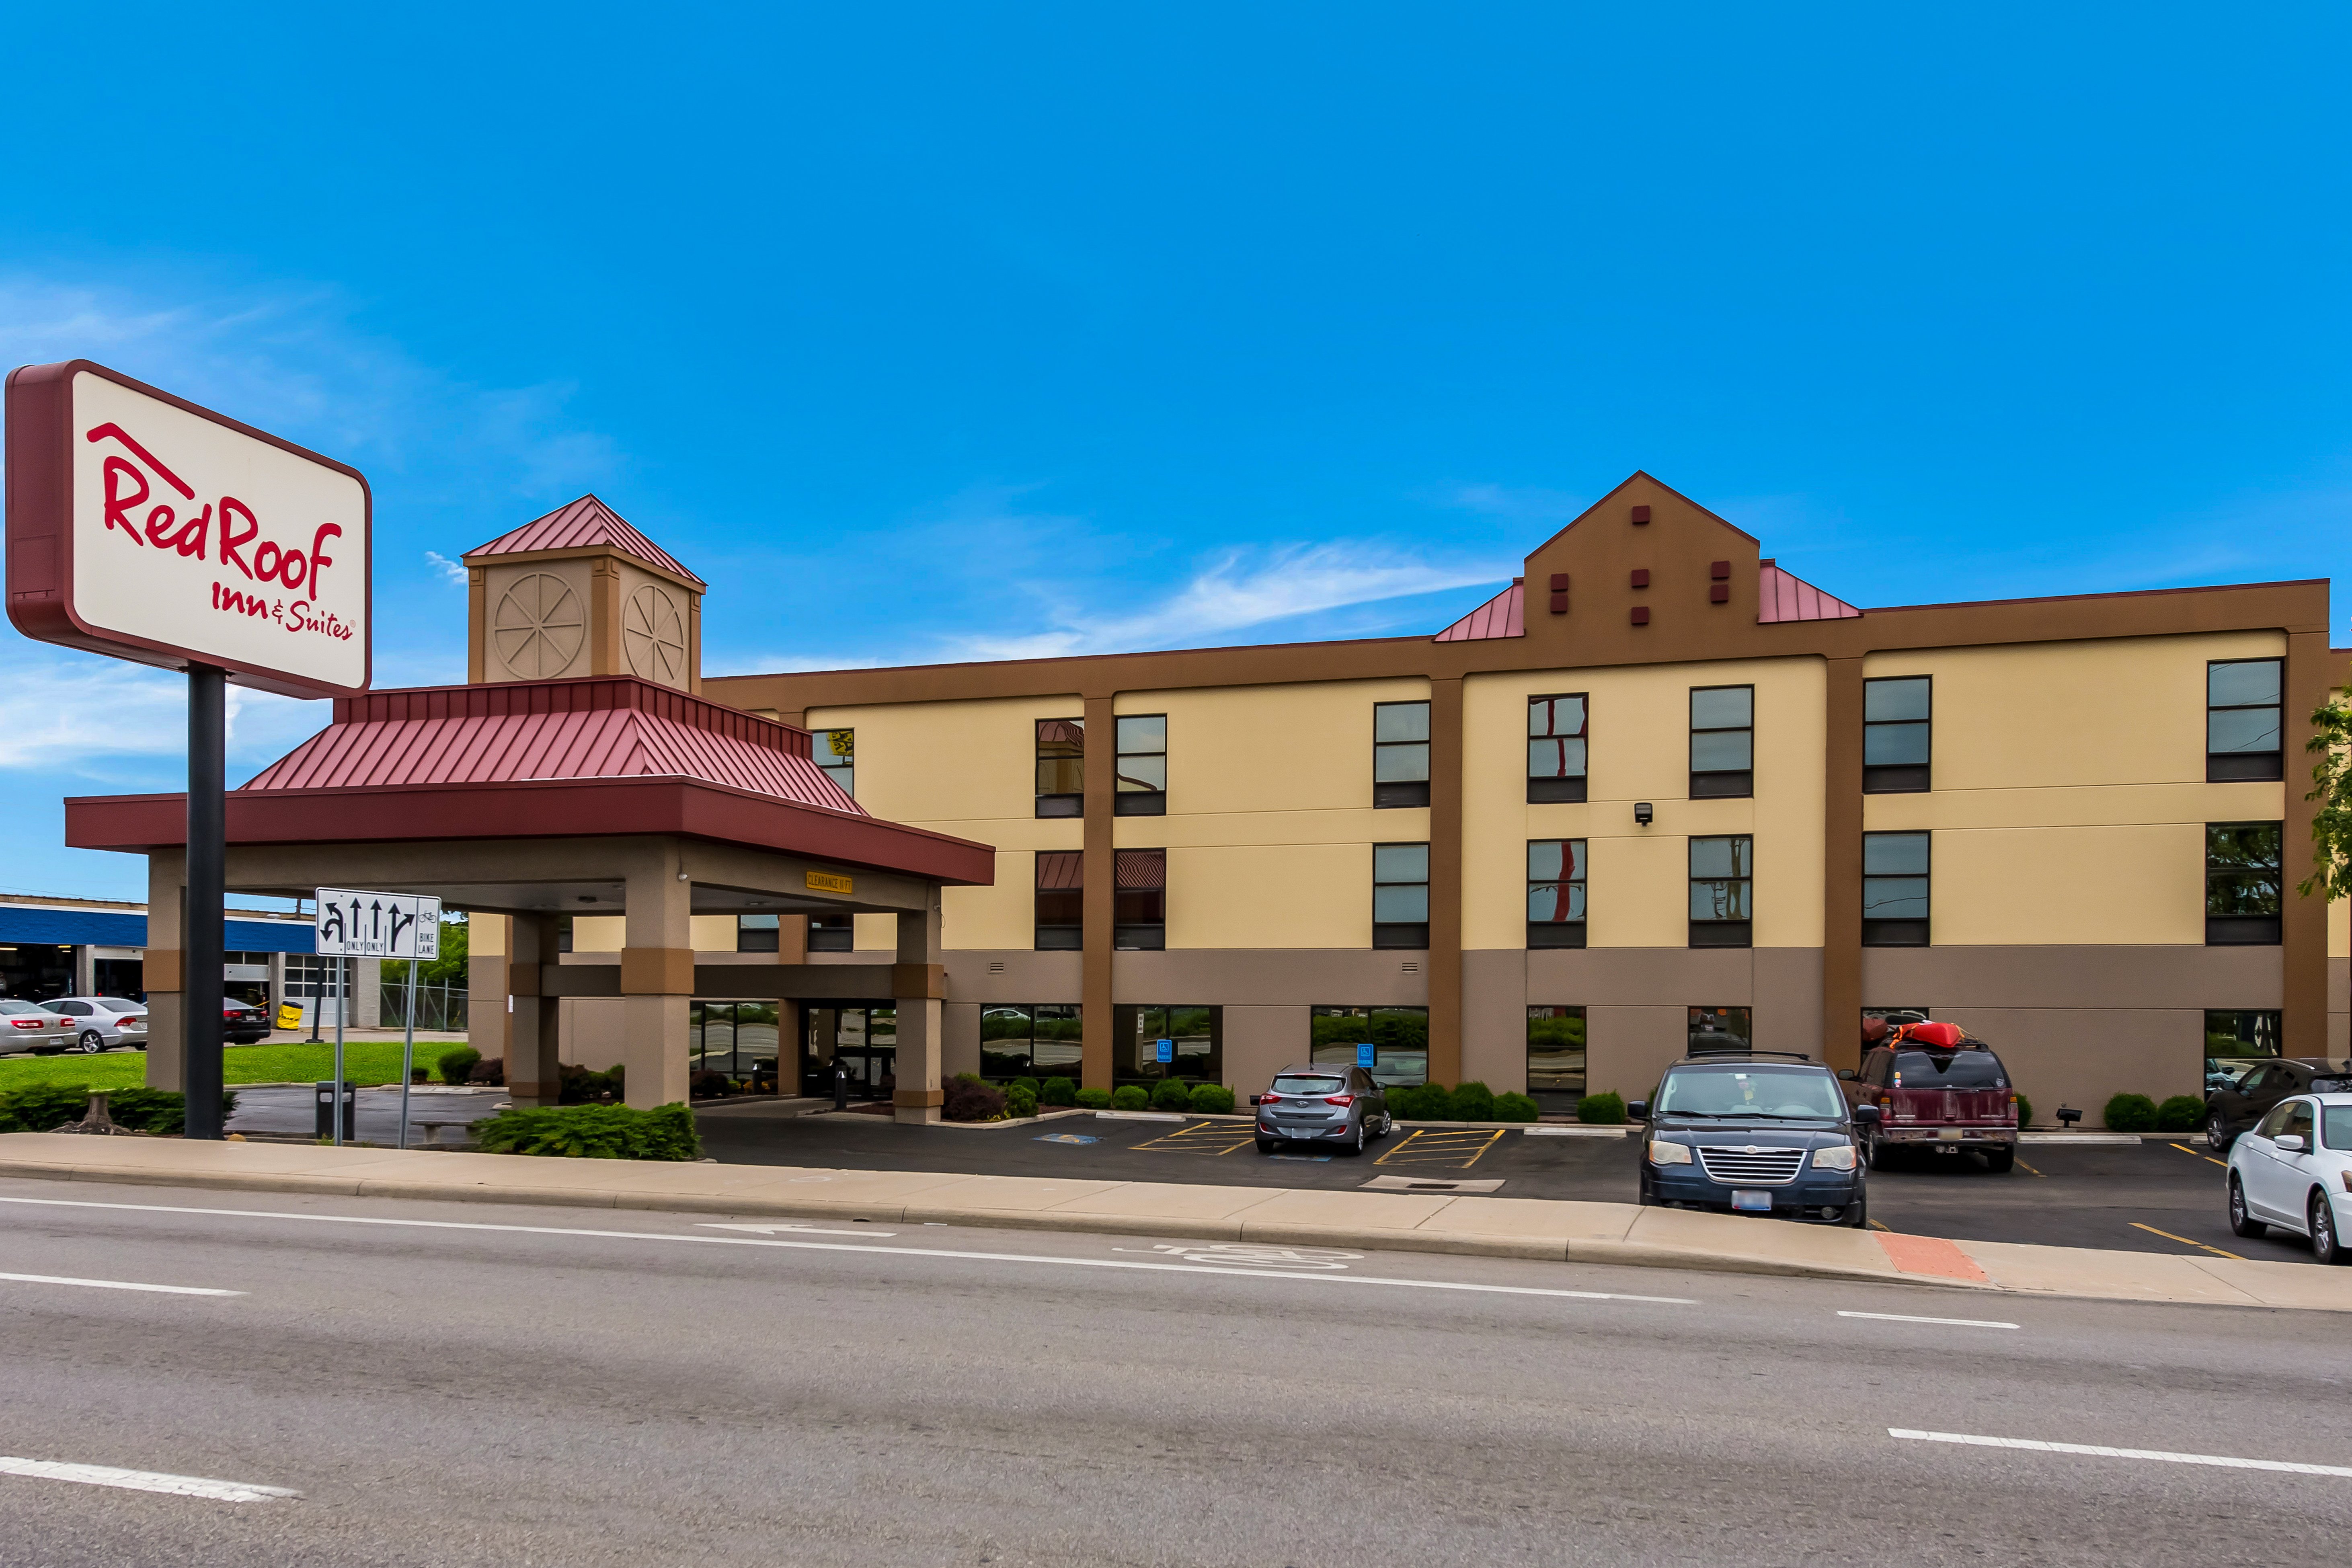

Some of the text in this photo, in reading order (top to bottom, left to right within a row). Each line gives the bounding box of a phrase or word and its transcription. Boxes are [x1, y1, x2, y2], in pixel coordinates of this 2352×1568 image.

[212, 581, 353, 640] Inn & Suites
[808, 874, 838, 889] CLEARANCE
[419, 933, 434, 942] BIKE
[346, 941, 364, 951] ONLY
[366, 942, 384, 952] ONLY
[418, 945, 434, 954] LANE
